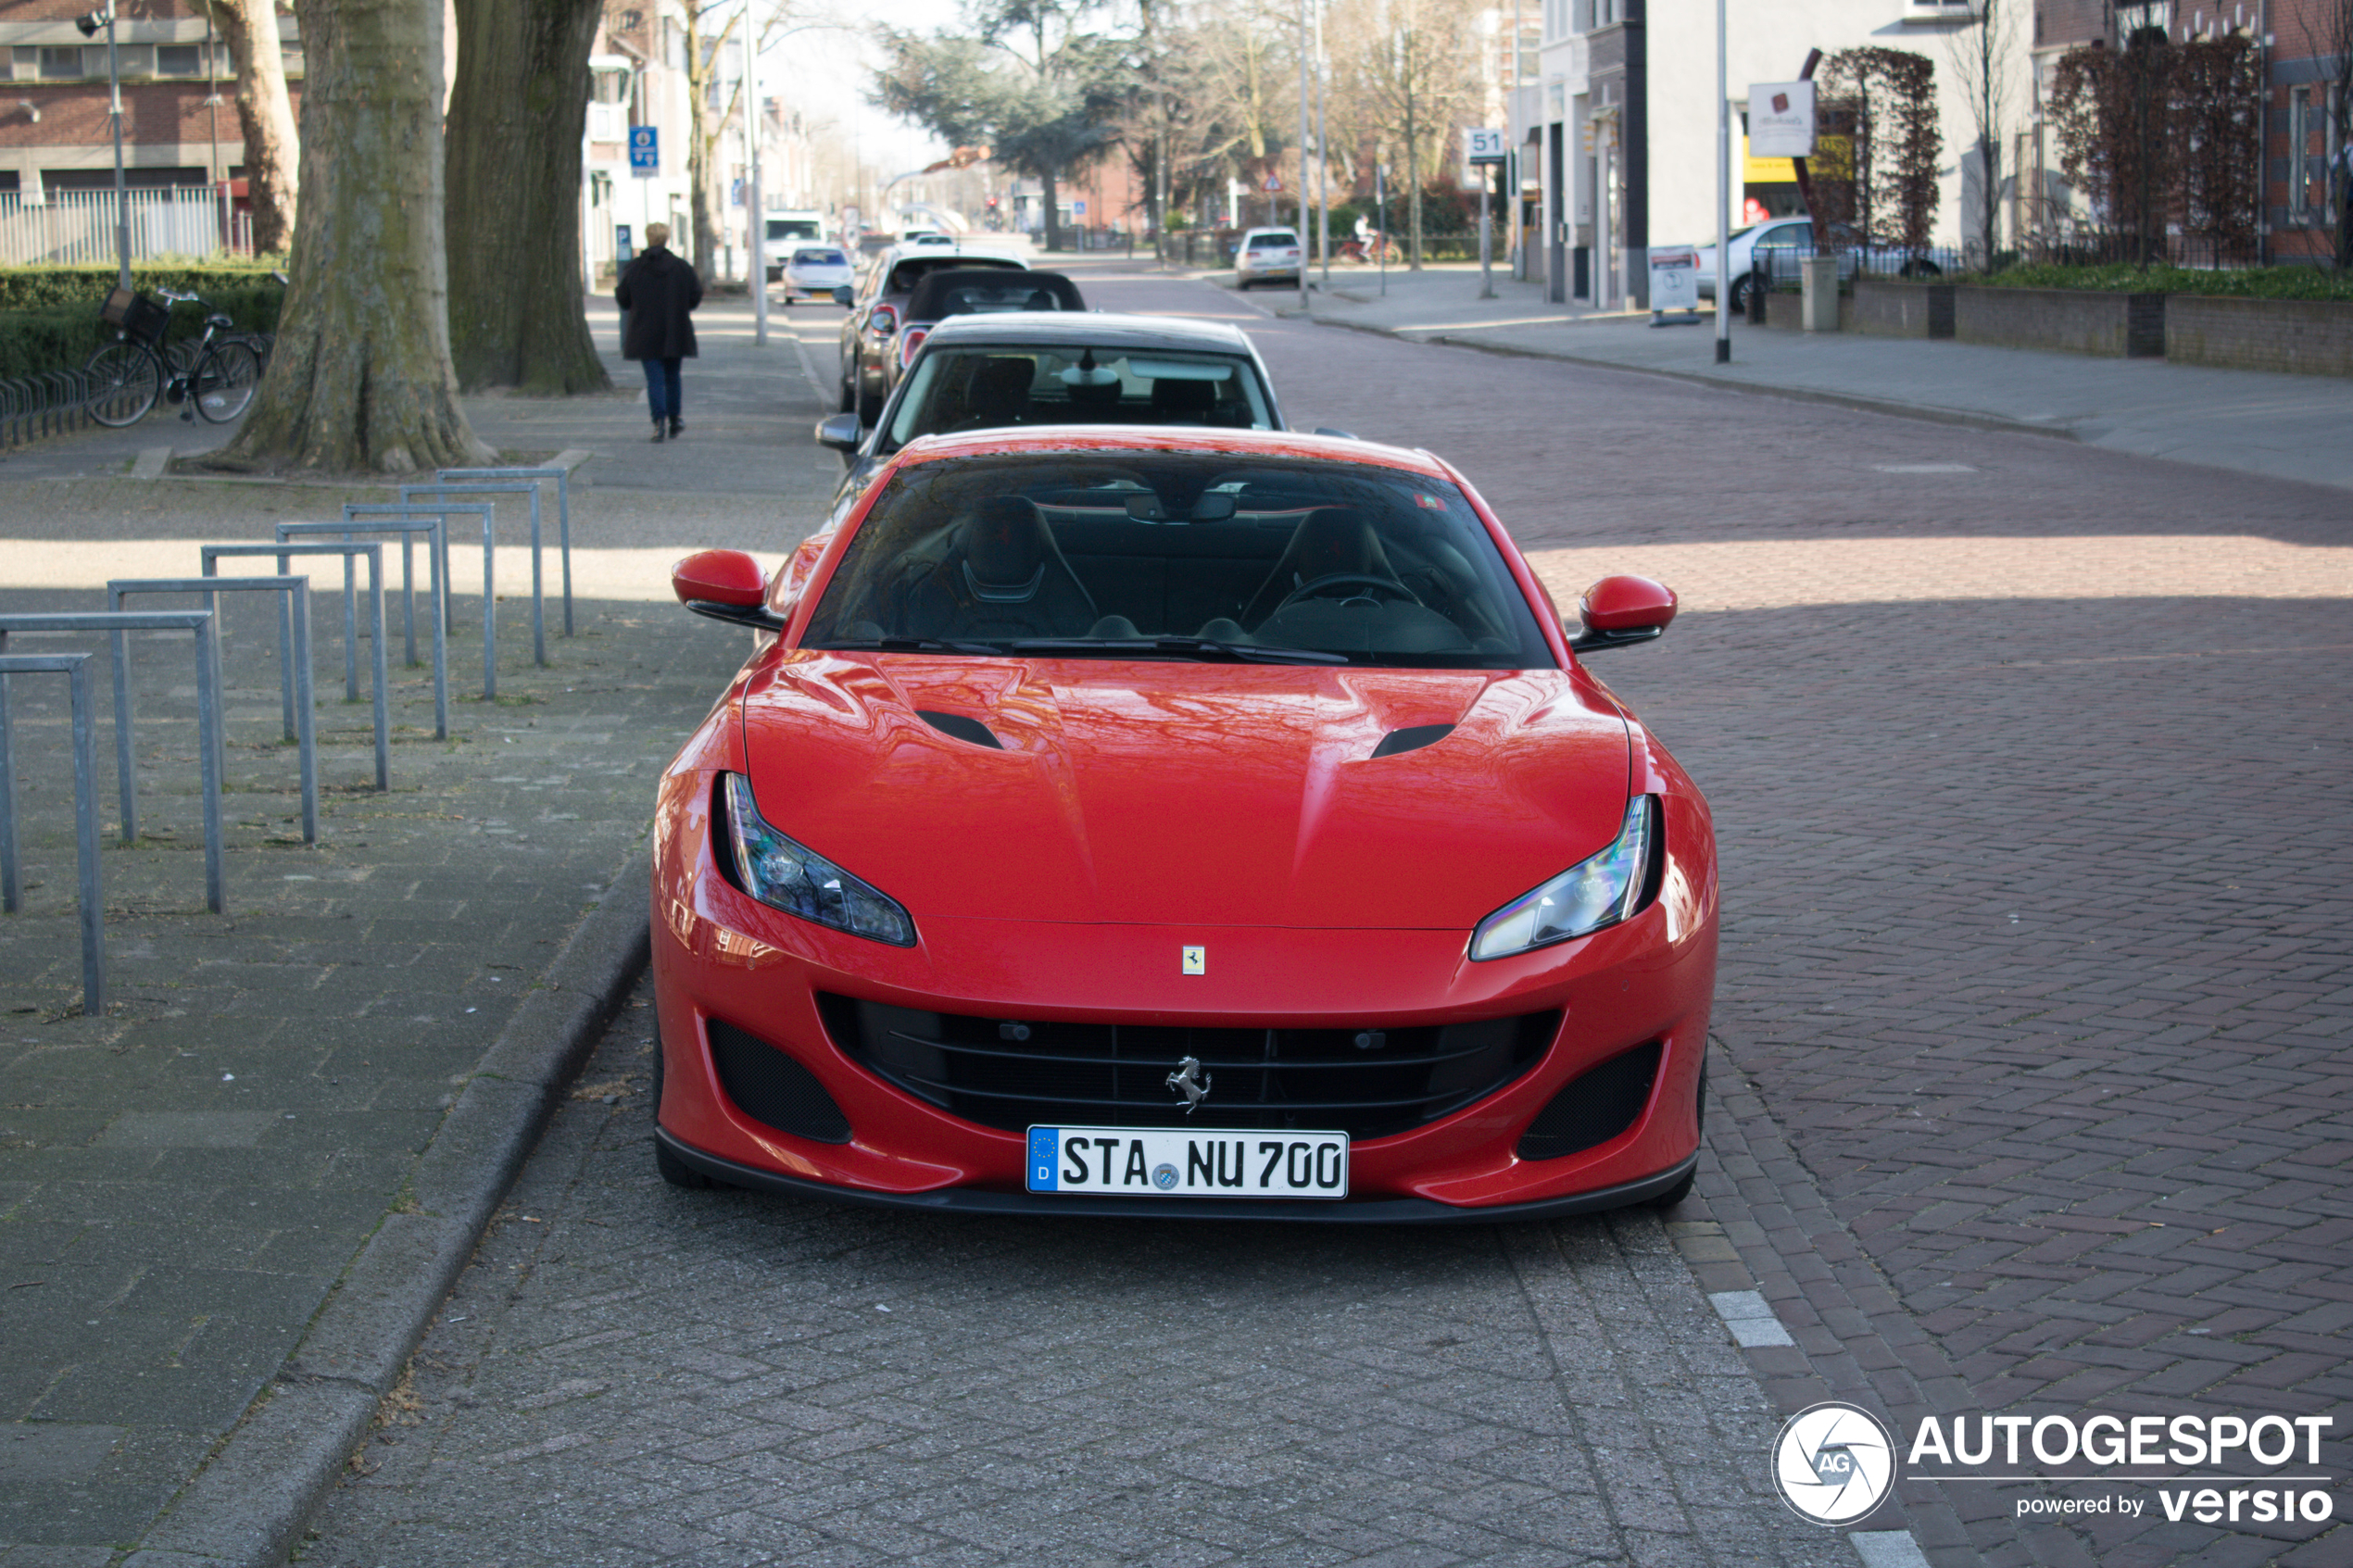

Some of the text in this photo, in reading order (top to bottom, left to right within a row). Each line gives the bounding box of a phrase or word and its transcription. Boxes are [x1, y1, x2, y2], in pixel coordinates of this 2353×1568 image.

[1473, 133, 1499, 151] 51
[618, 230, 628, 245] P
[1063, 1136, 1149, 1186] STA
[1187, 1140, 1245, 1188] NU
[1258, 1141, 1341, 1189] 700
[1038, 1166, 1050, 1180] D
